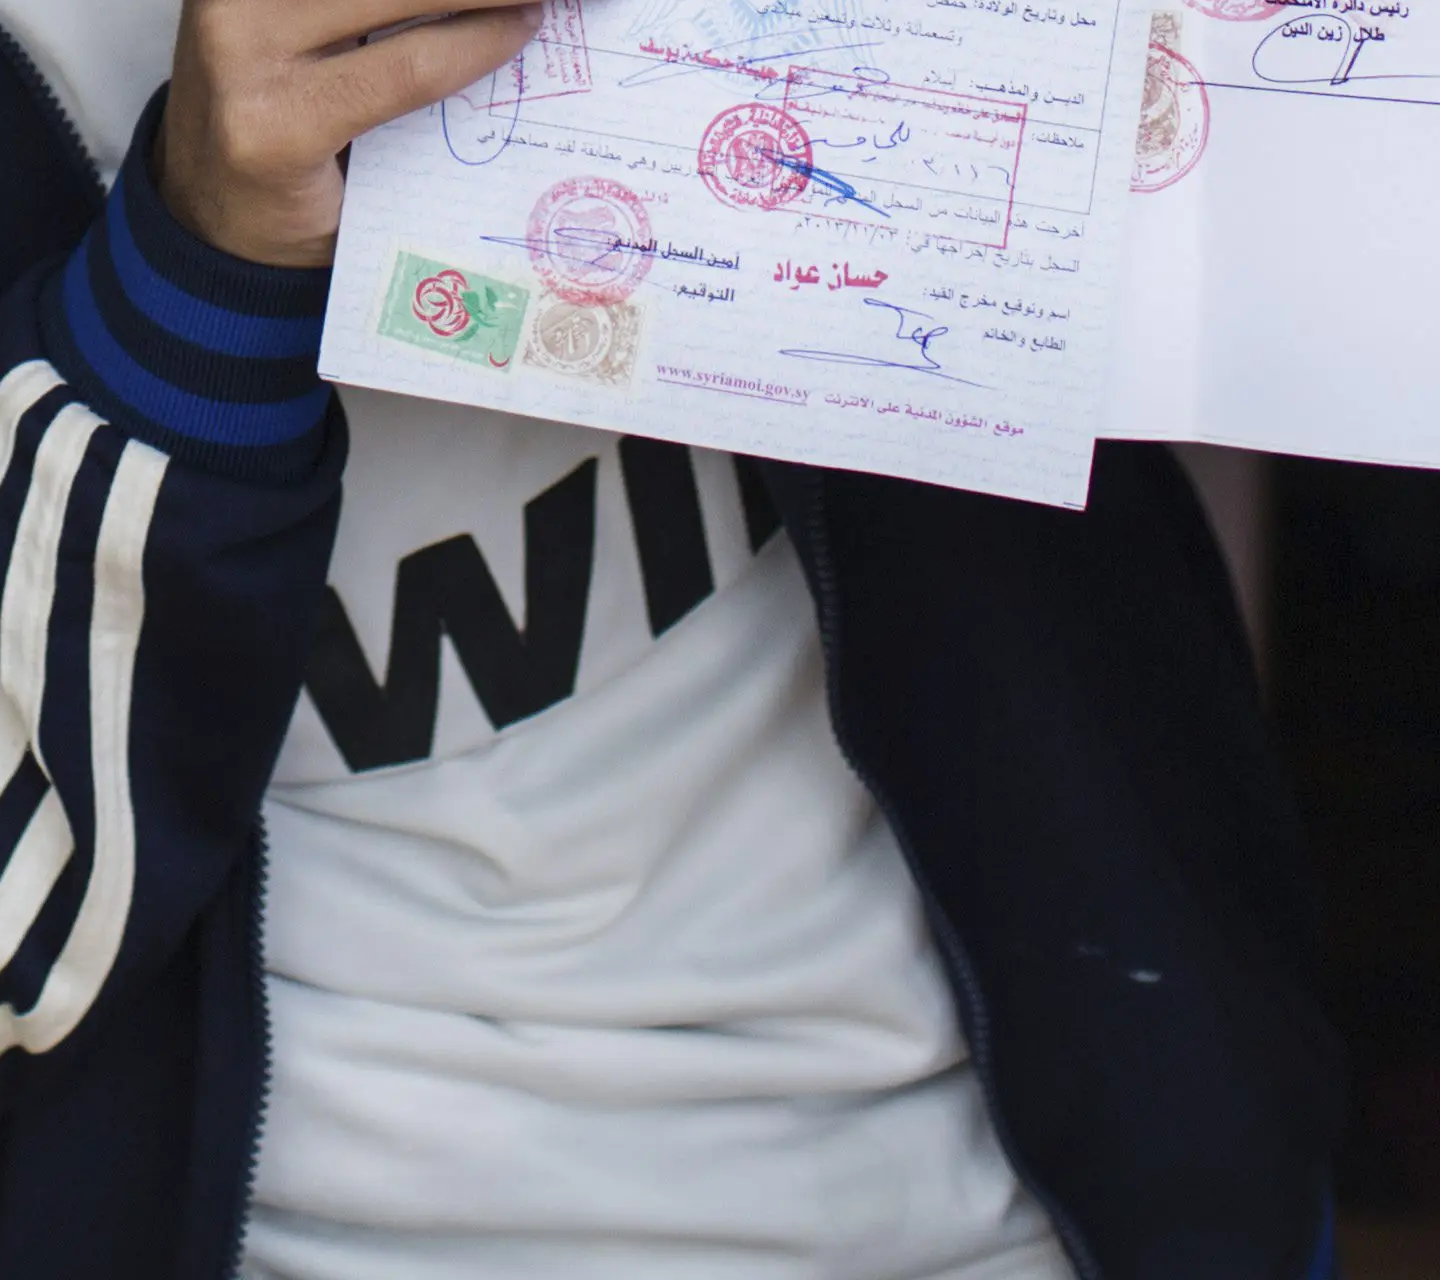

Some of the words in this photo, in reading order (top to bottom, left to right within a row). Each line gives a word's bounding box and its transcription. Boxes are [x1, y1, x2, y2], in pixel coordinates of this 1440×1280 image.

[1369, 2, 1409, 17] رئيس
[1317, 26, 1343, 41] زين
[773, 260, 820, 289] عواد
[656, 362, 810, 401] www.syriamoi.gov.sy
[905, 403, 942, 423] المدنية
[945, 413, 987, 430] الشؤون
[992, 419, 1023, 436] موقع
